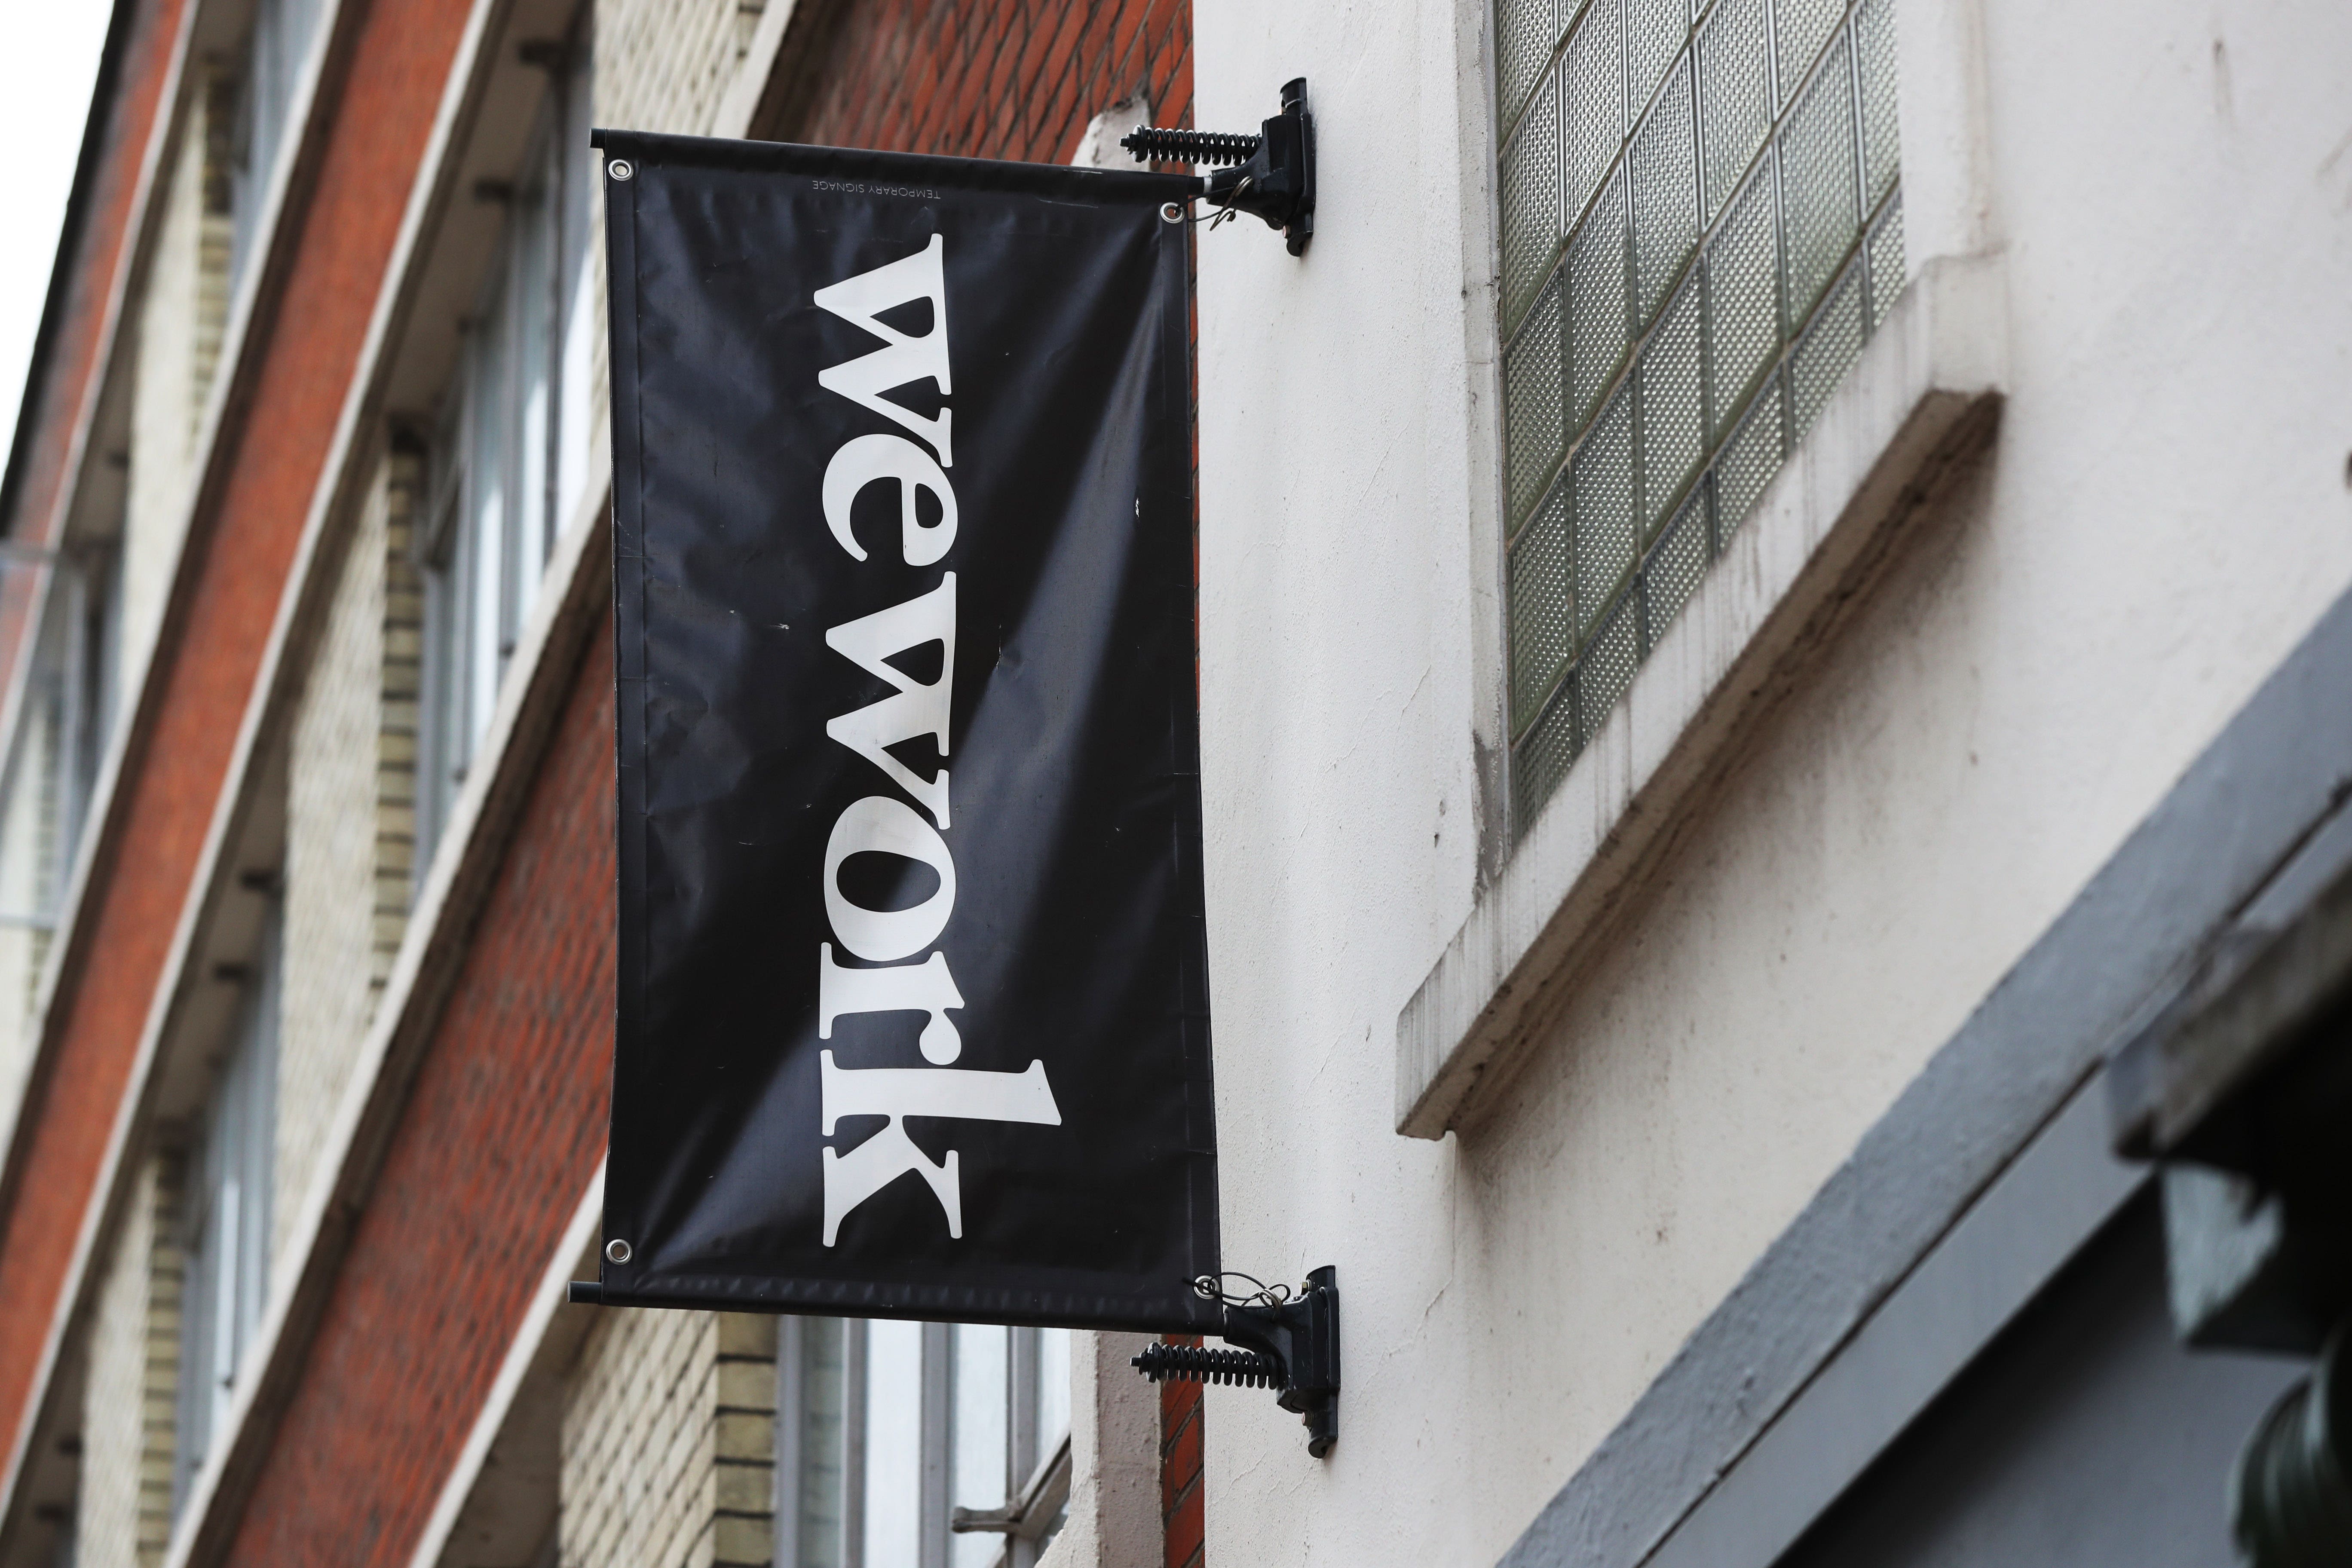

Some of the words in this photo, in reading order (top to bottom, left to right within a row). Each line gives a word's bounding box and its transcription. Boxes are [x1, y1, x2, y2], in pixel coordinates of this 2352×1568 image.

[812, 180, 864, 193] SIGNAGE
[868, 185, 941, 199] TEMPORARY
[814, 233, 1062, 1248] wework
